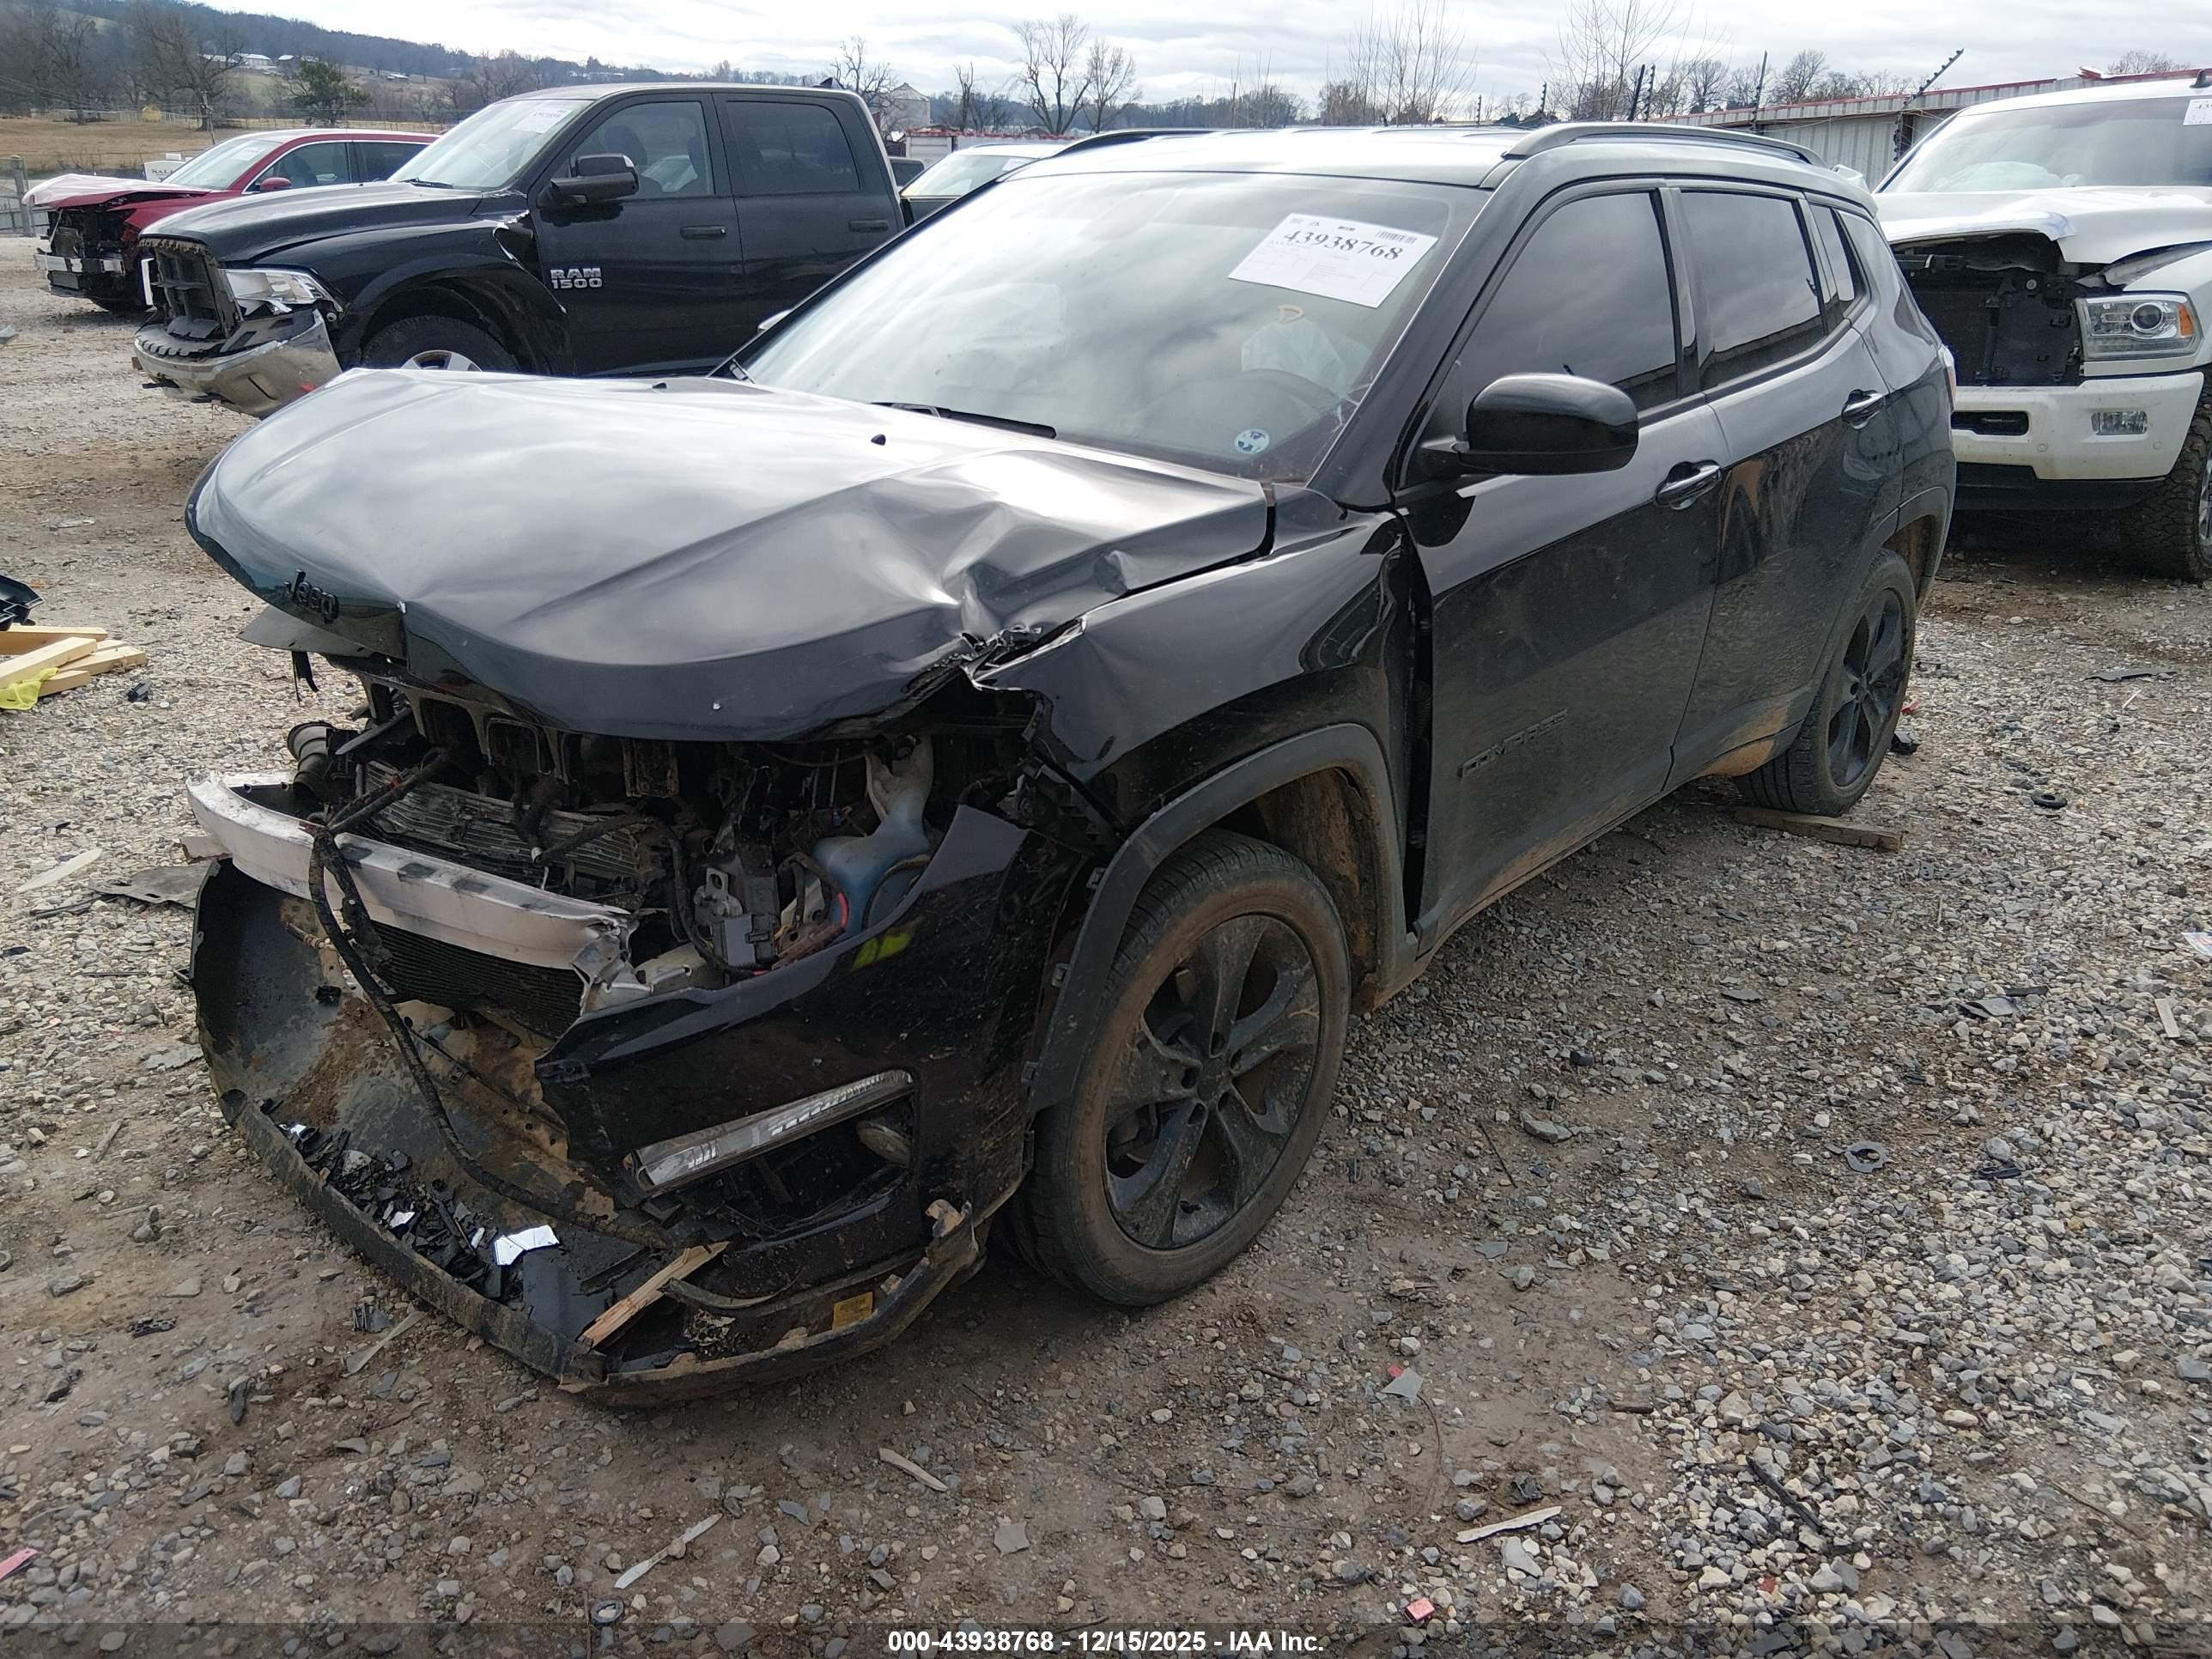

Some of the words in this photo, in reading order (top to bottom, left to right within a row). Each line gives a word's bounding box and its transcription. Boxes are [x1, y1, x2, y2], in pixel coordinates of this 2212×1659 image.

[1284, 231, 1403, 259] 43938768
[550, 267, 602, 279] RAM
[550, 277, 603, 289] 1500
[282, 568, 341, 624] Jeep
